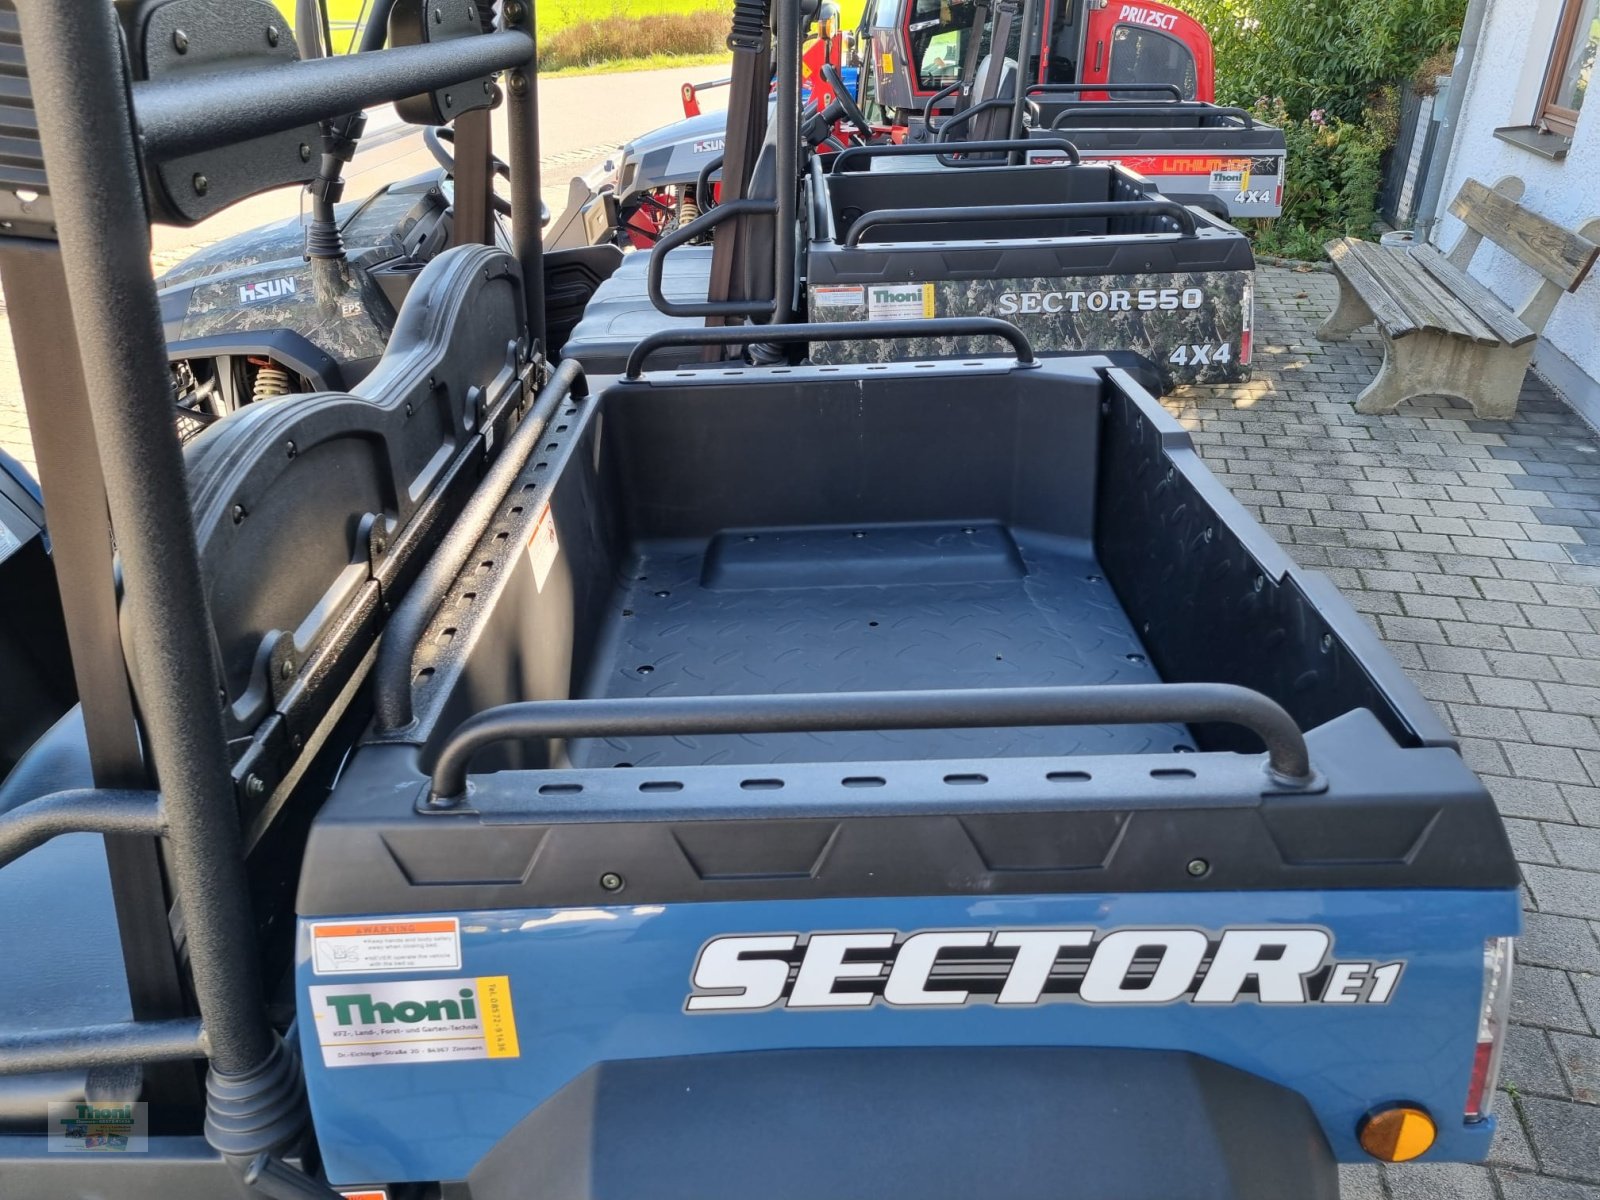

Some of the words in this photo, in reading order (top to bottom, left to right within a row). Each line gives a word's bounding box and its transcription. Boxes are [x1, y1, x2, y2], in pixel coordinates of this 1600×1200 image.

[1213, 173, 1242, 182] Thoni
[1234, 189, 1270, 204] 4X4
[239, 276, 296, 303] HSUN
[873, 288, 922, 304] Thoni
[341, 302, 361, 314] EPS
[999, 290, 1131, 316] SECTOR
[1136, 287, 1202, 310] 550
[1169, 343, 1231, 367] 4X4
[363, 924, 416, 934] WARNING
[685, 928, 1332, 1011] SECTOR
[1321, 961, 1404, 1005] E1
[325, 988, 477, 1026] Thoni
